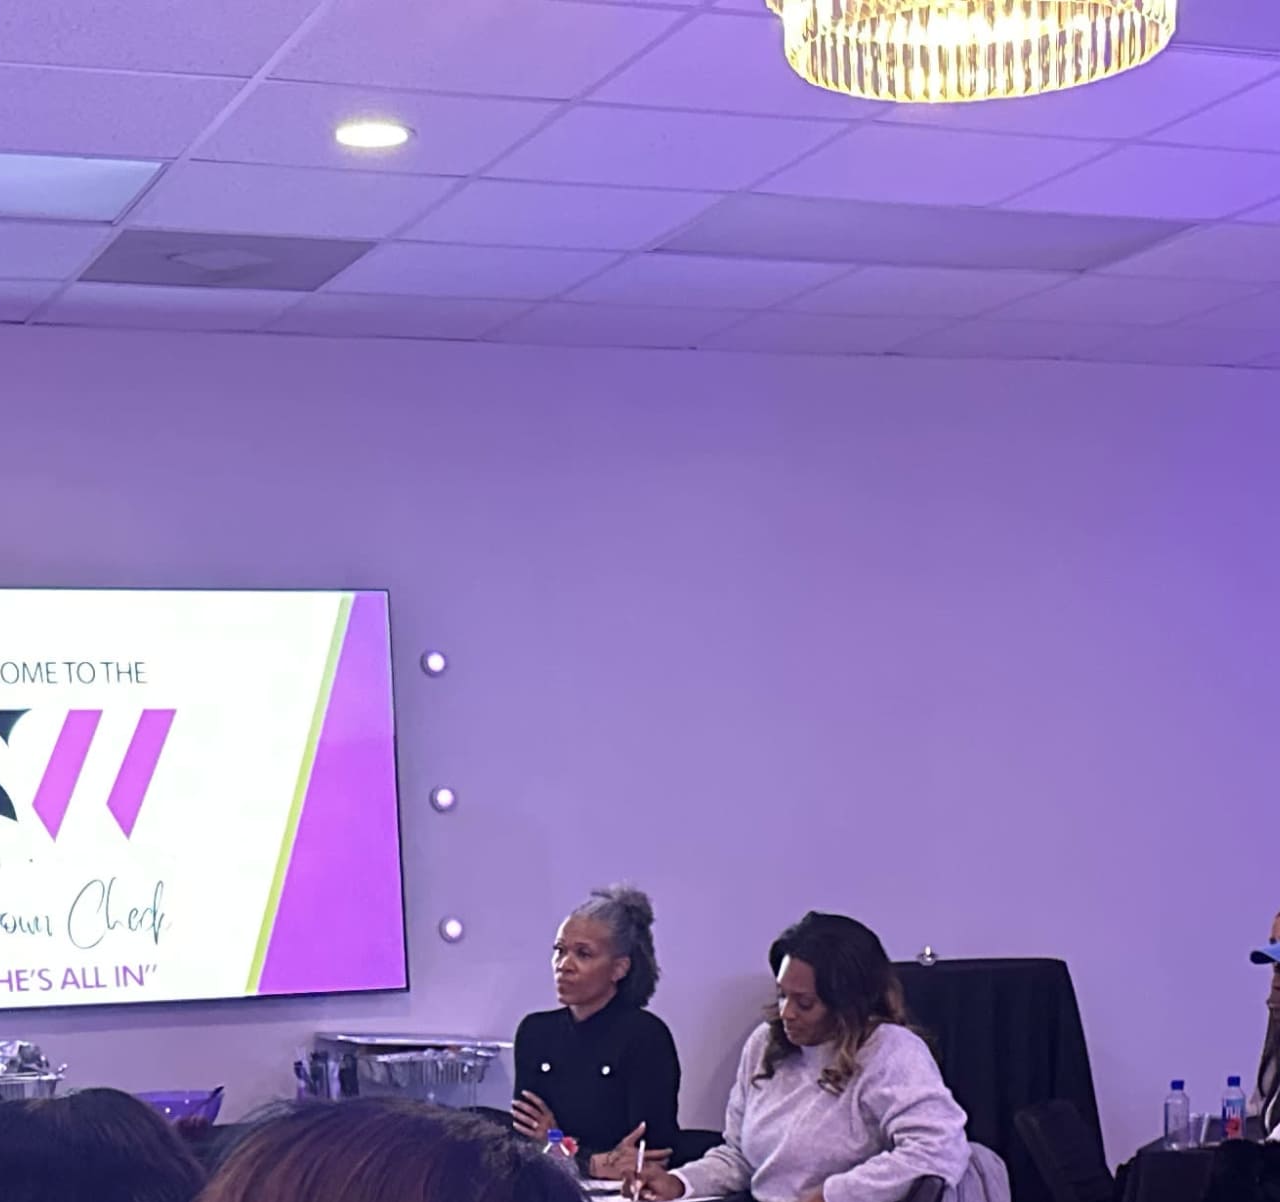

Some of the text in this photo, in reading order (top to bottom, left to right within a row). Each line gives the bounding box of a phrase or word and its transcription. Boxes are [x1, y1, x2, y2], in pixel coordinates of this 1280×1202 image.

[62, 661, 96, 685] TO
[99, 661, 148, 685] THE
[60, 966, 107, 990] ALL
[114, 964, 158, 988] IN"
